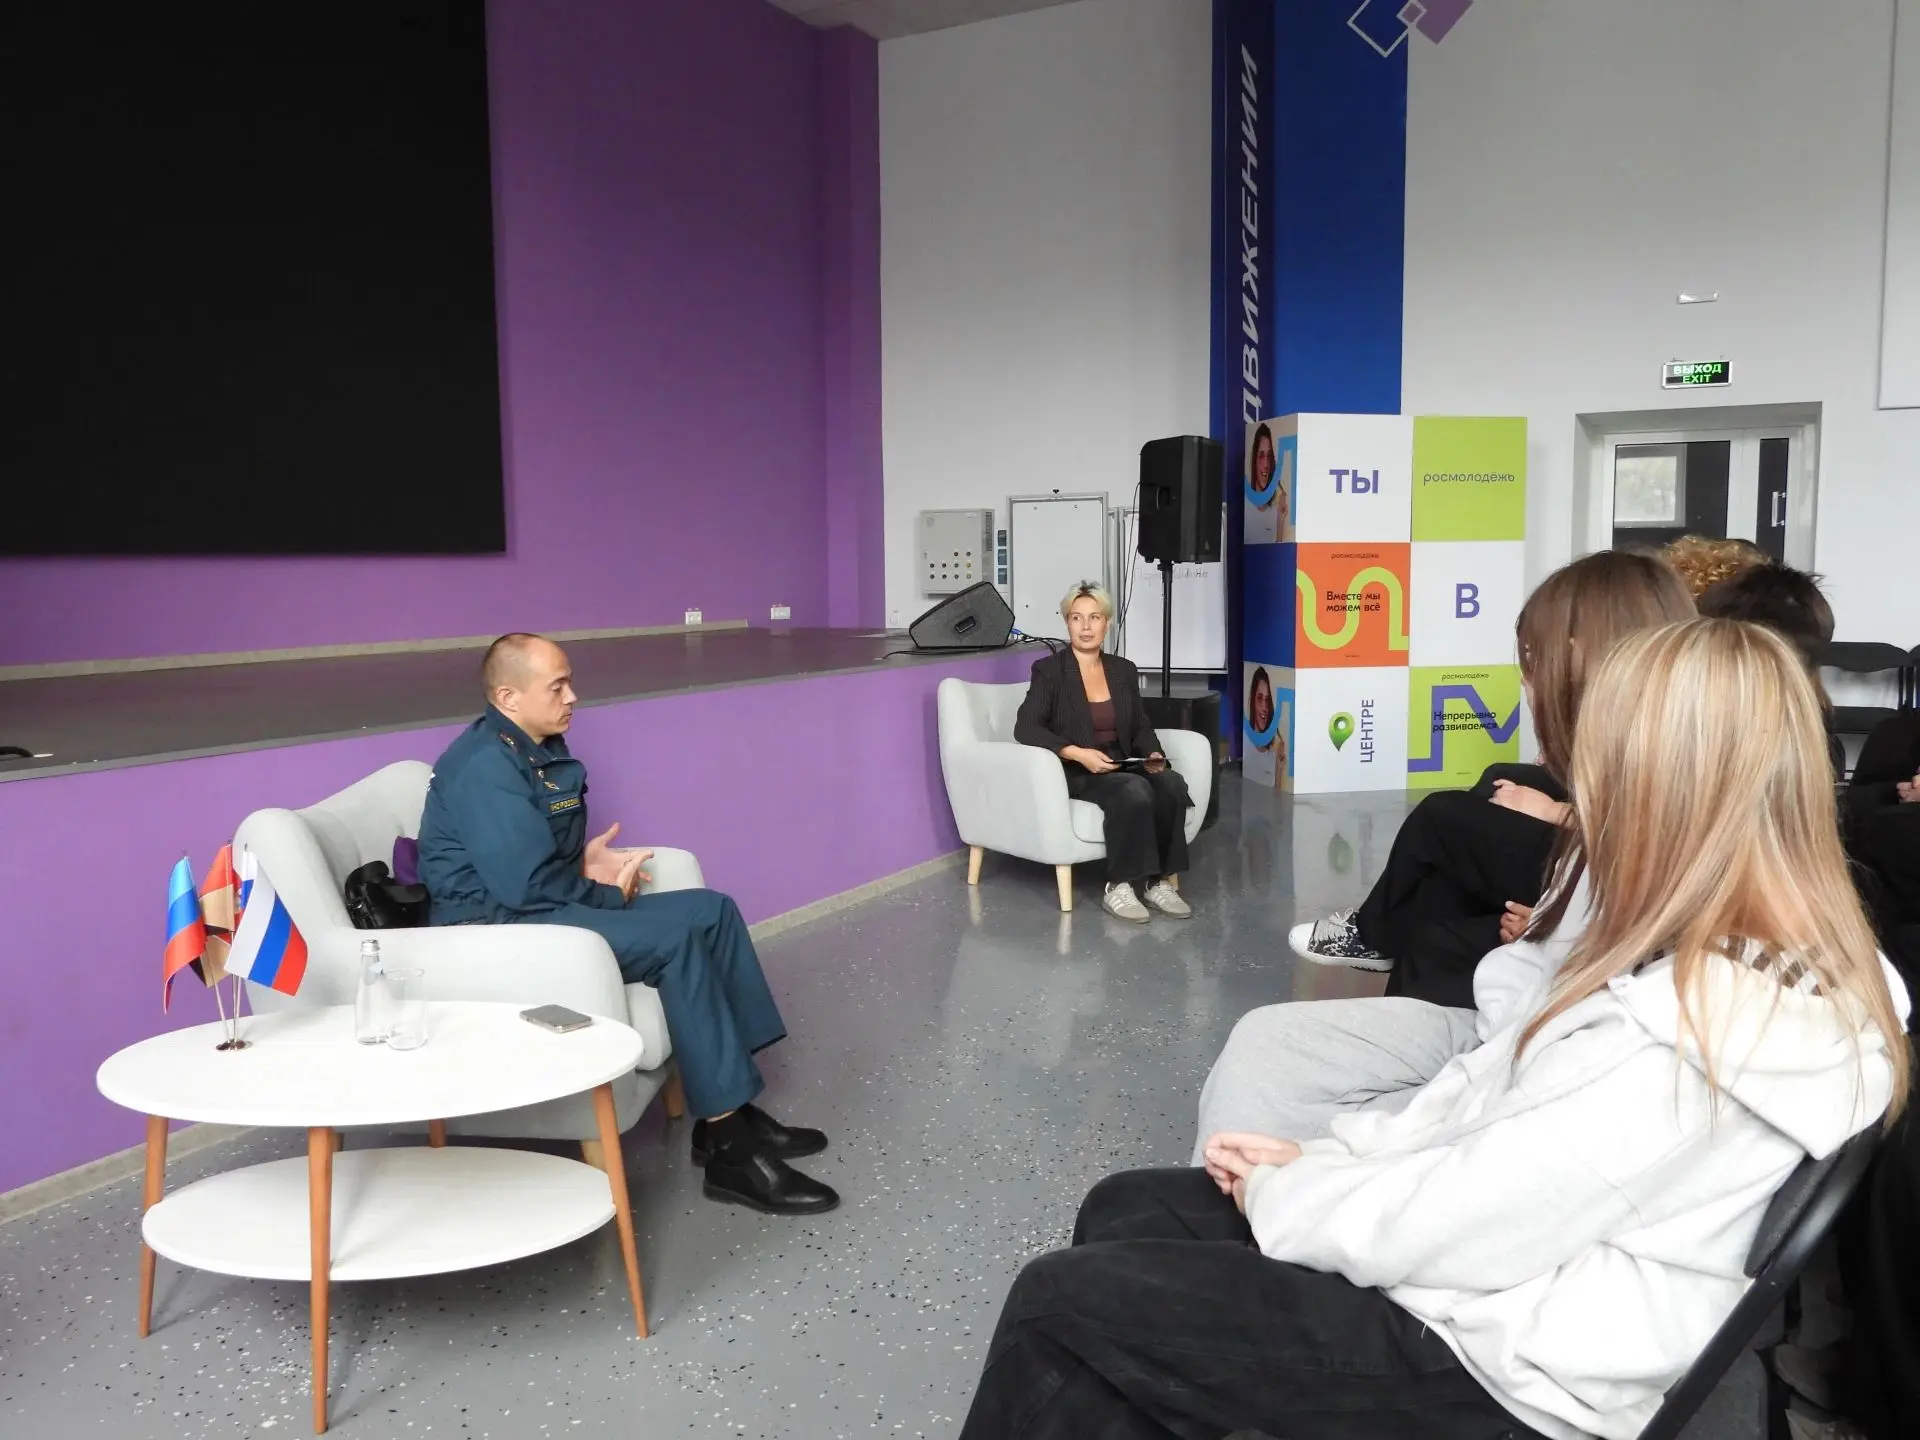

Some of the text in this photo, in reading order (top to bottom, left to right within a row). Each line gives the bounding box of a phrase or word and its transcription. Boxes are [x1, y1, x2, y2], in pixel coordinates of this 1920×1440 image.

[1242, 43, 1262, 424] ДВИЖЕНИИ
[1673, 363, 1722, 375] ВЫХОД
[1683, 374, 1711, 384] EXIT
[1329, 469, 1379, 494] ТЫ
[1423, 472, 1515, 487] росмолодёжь
[1326, 591, 1362, 601] Вместе
[1455, 583, 1480, 618] В
[1326, 602, 1381, 612] можем всё
[1433, 711, 1497, 721] Непрерывно
[1360, 699, 1374, 763] ЦЕНТРЕ
[1432, 722, 1498, 733] развиваемся
